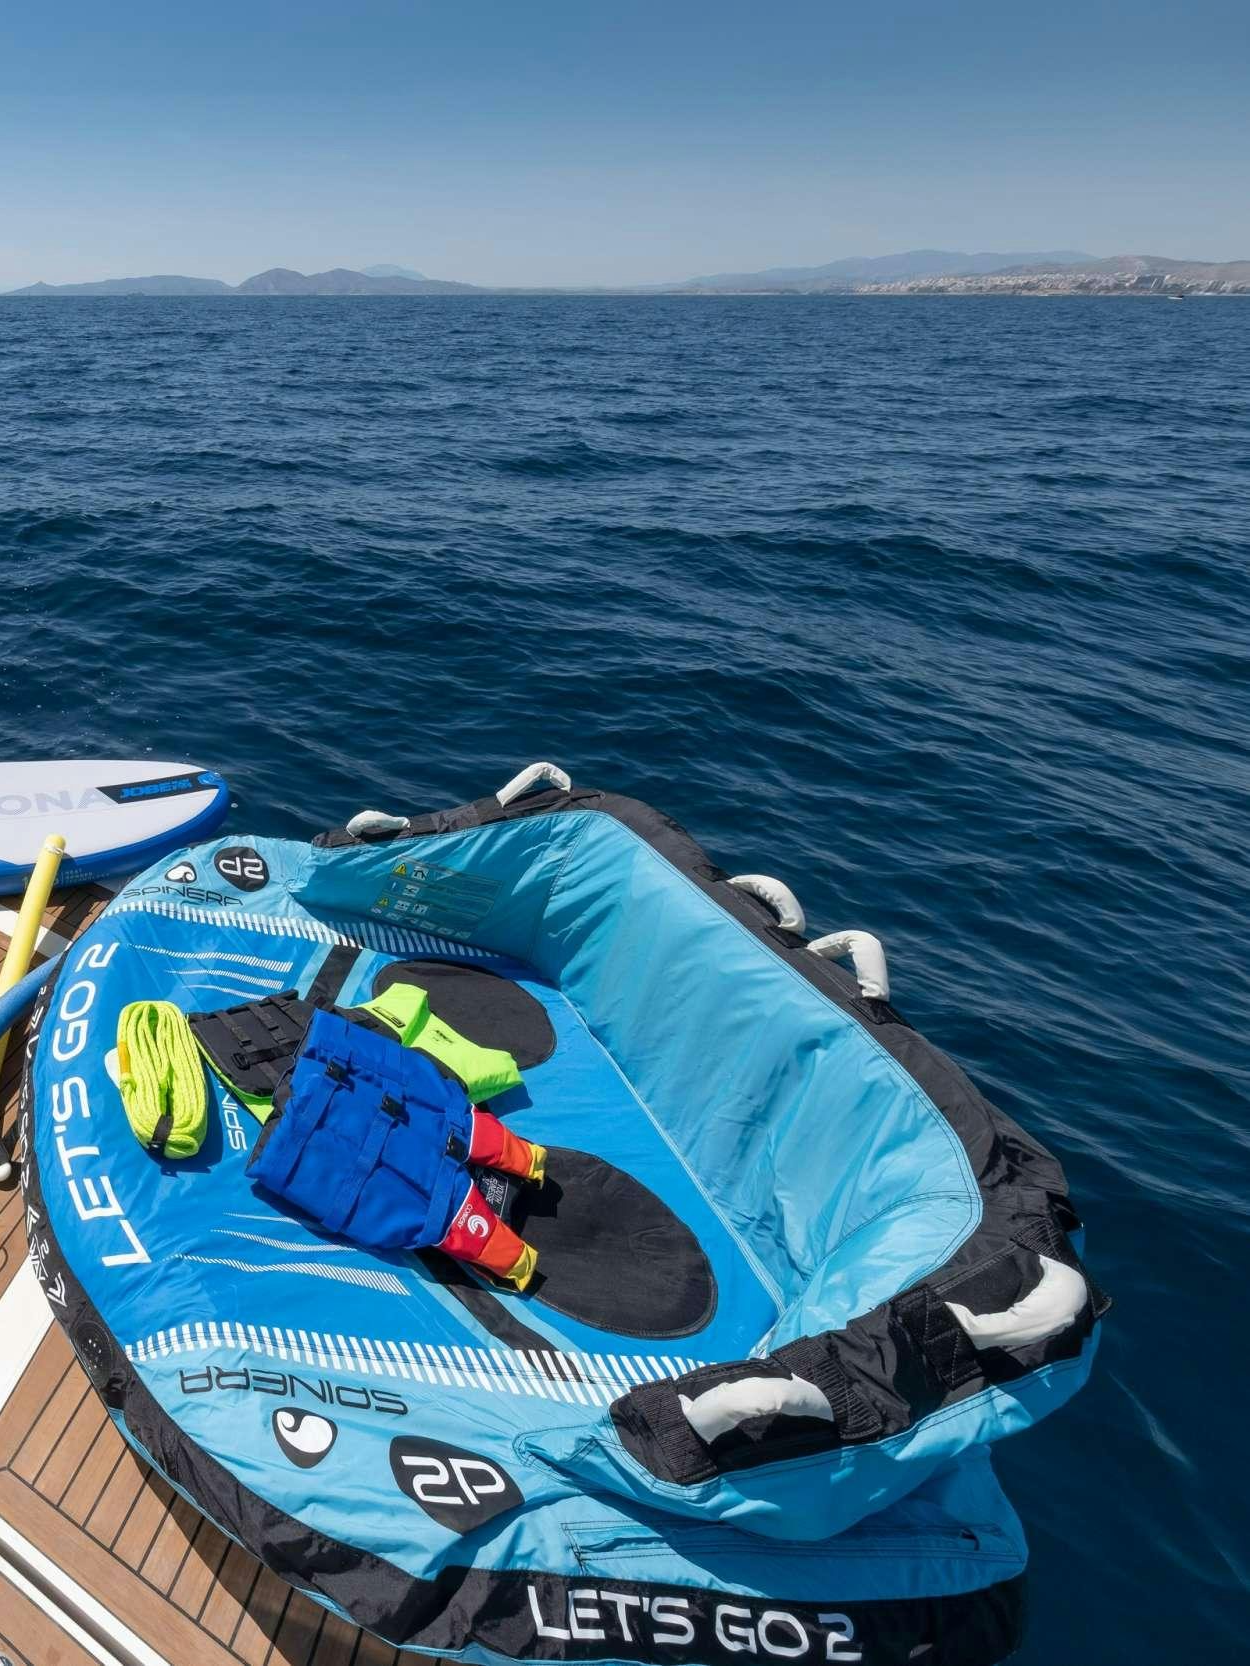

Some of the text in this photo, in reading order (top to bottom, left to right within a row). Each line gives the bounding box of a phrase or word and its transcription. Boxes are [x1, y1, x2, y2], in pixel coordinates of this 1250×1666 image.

[219, 856, 265, 881] 2P
[123, 884, 244, 907] SPINERA
[75, 941, 121, 969] 2
[51, 980, 96, 1062] GO
[221, 1083, 248, 1153] SPIN
[51, 1075, 152, 1267] LET'S
[180, 1365, 409, 1417] SPINERA
[400, 1455, 506, 1506] 2P
[527, 1584, 863, 1662] LET'S GO 2
